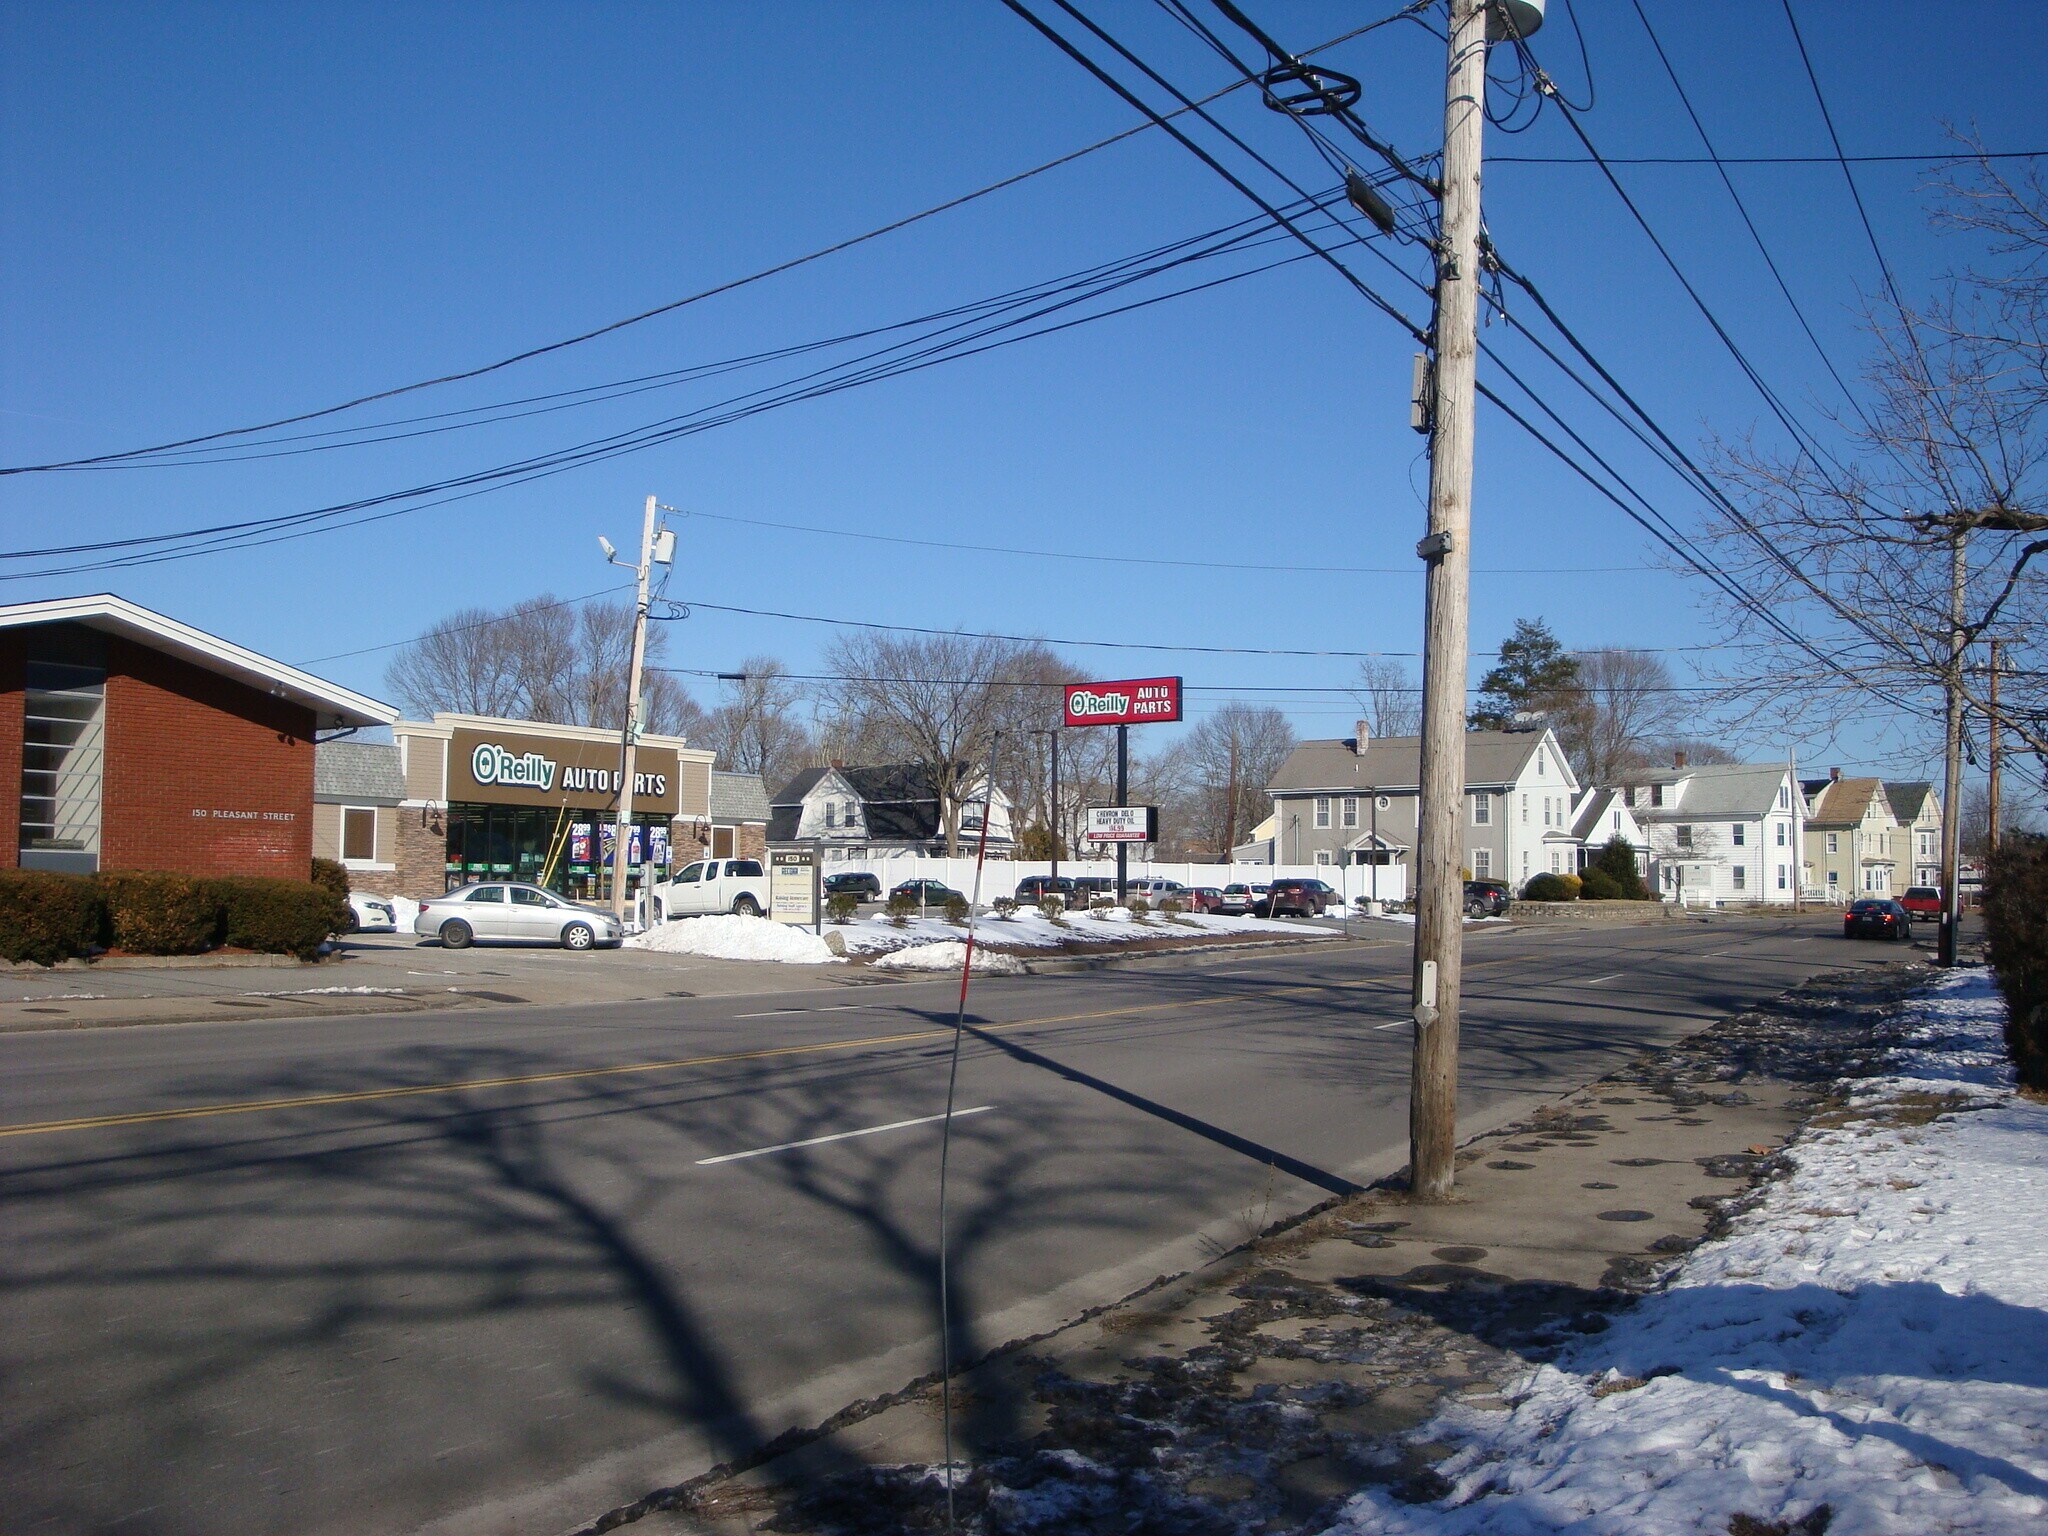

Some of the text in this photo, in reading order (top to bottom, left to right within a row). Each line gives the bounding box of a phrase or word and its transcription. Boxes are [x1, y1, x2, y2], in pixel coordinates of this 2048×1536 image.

[1137, 686, 1168, 700] AUTO
[1070, 691, 1130, 716] O'Reilly
[1133, 701, 1171, 714] PARTS
[474, 744, 666, 795] O'Reilly AUTO PRTS
[192, 809, 295, 821] 150 PLEASANT STREET
[1096, 810, 1118, 818] CHEVRON
